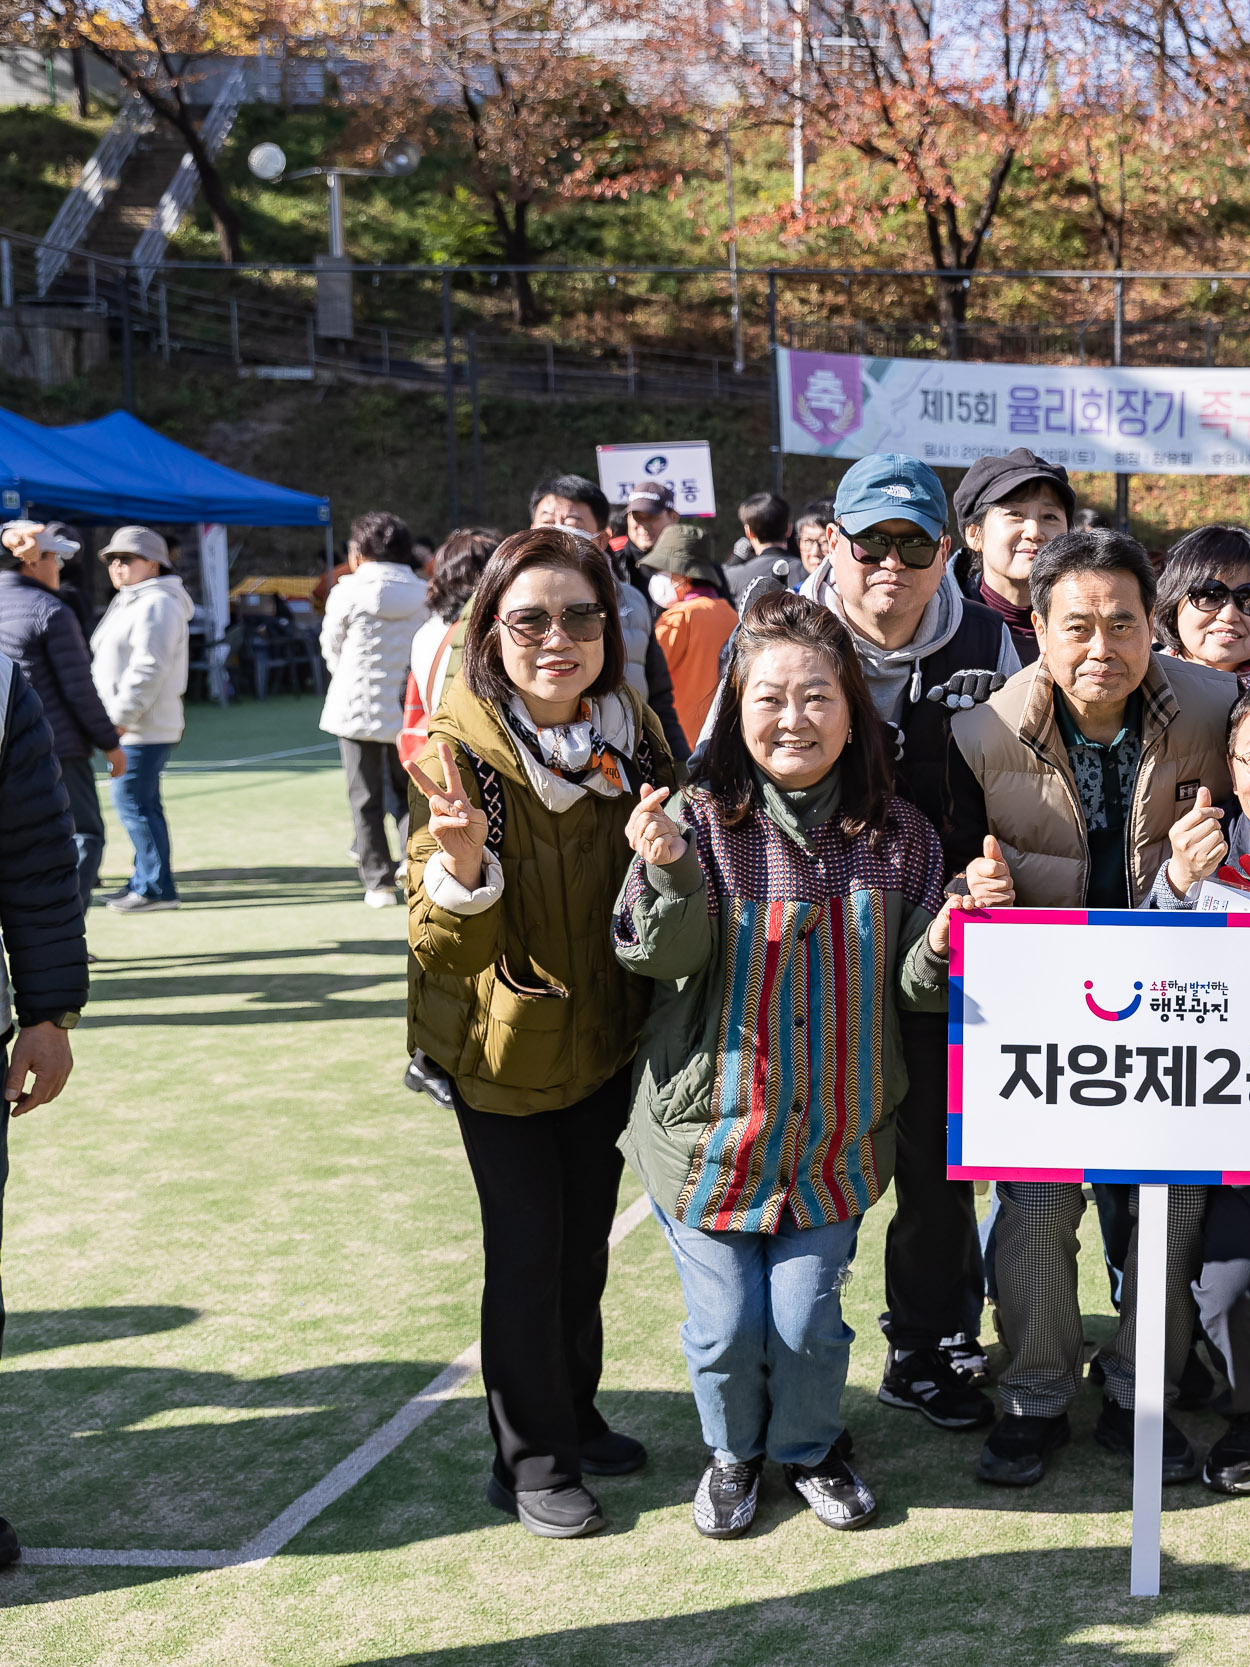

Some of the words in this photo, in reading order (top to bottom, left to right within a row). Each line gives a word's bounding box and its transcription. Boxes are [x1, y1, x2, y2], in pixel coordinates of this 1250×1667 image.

[804, 369, 847, 417] 축
[920, 388, 997, 426] 제15회
[1008, 385, 1185, 438] 율리회장기
[1149, 980, 1188, 997] 소통하며
[1189, 981, 1229, 997] 발전하는
[1149, 995, 1228, 1024] 행복광진
